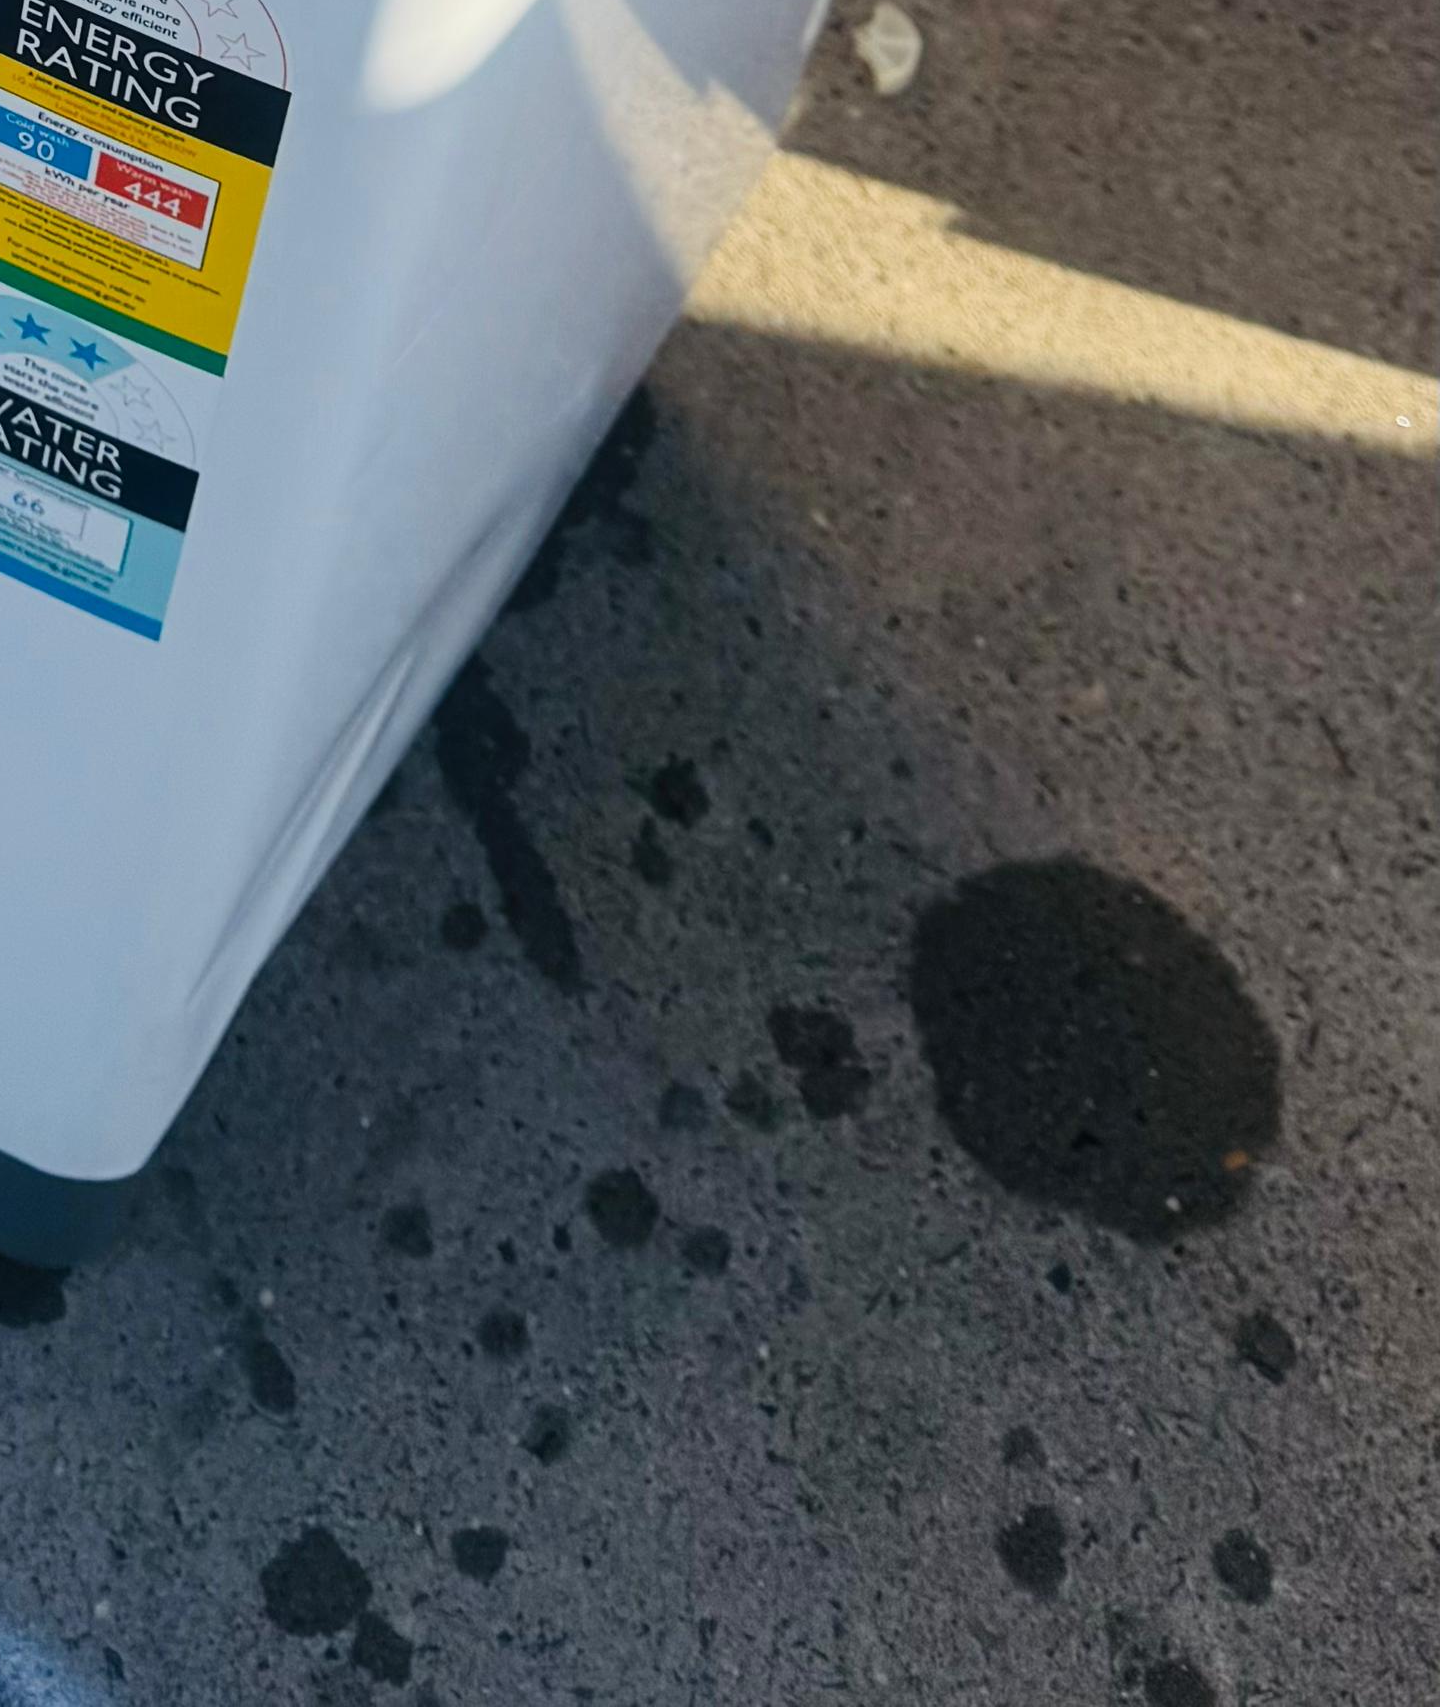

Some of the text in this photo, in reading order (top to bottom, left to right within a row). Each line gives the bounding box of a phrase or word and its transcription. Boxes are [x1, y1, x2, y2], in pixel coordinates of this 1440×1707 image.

[121, 10, 178, 40] efficient
[141, 4, 181, 26] more
[16, 28, 201, 130] RATING
[5, 113, 70, 148] Cold wash
[17, 131, 56, 162] 90
[38, 111, 79, 138] Energy
[82, 133, 164, 173] consumption
[44, 166, 131, 210] kWh per year
[116, 161, 192, 201] Warm wash
[123, 181, 182, 217] 444
[24, 356, 47, 375] The
[13, 490, 45, 516] 66
